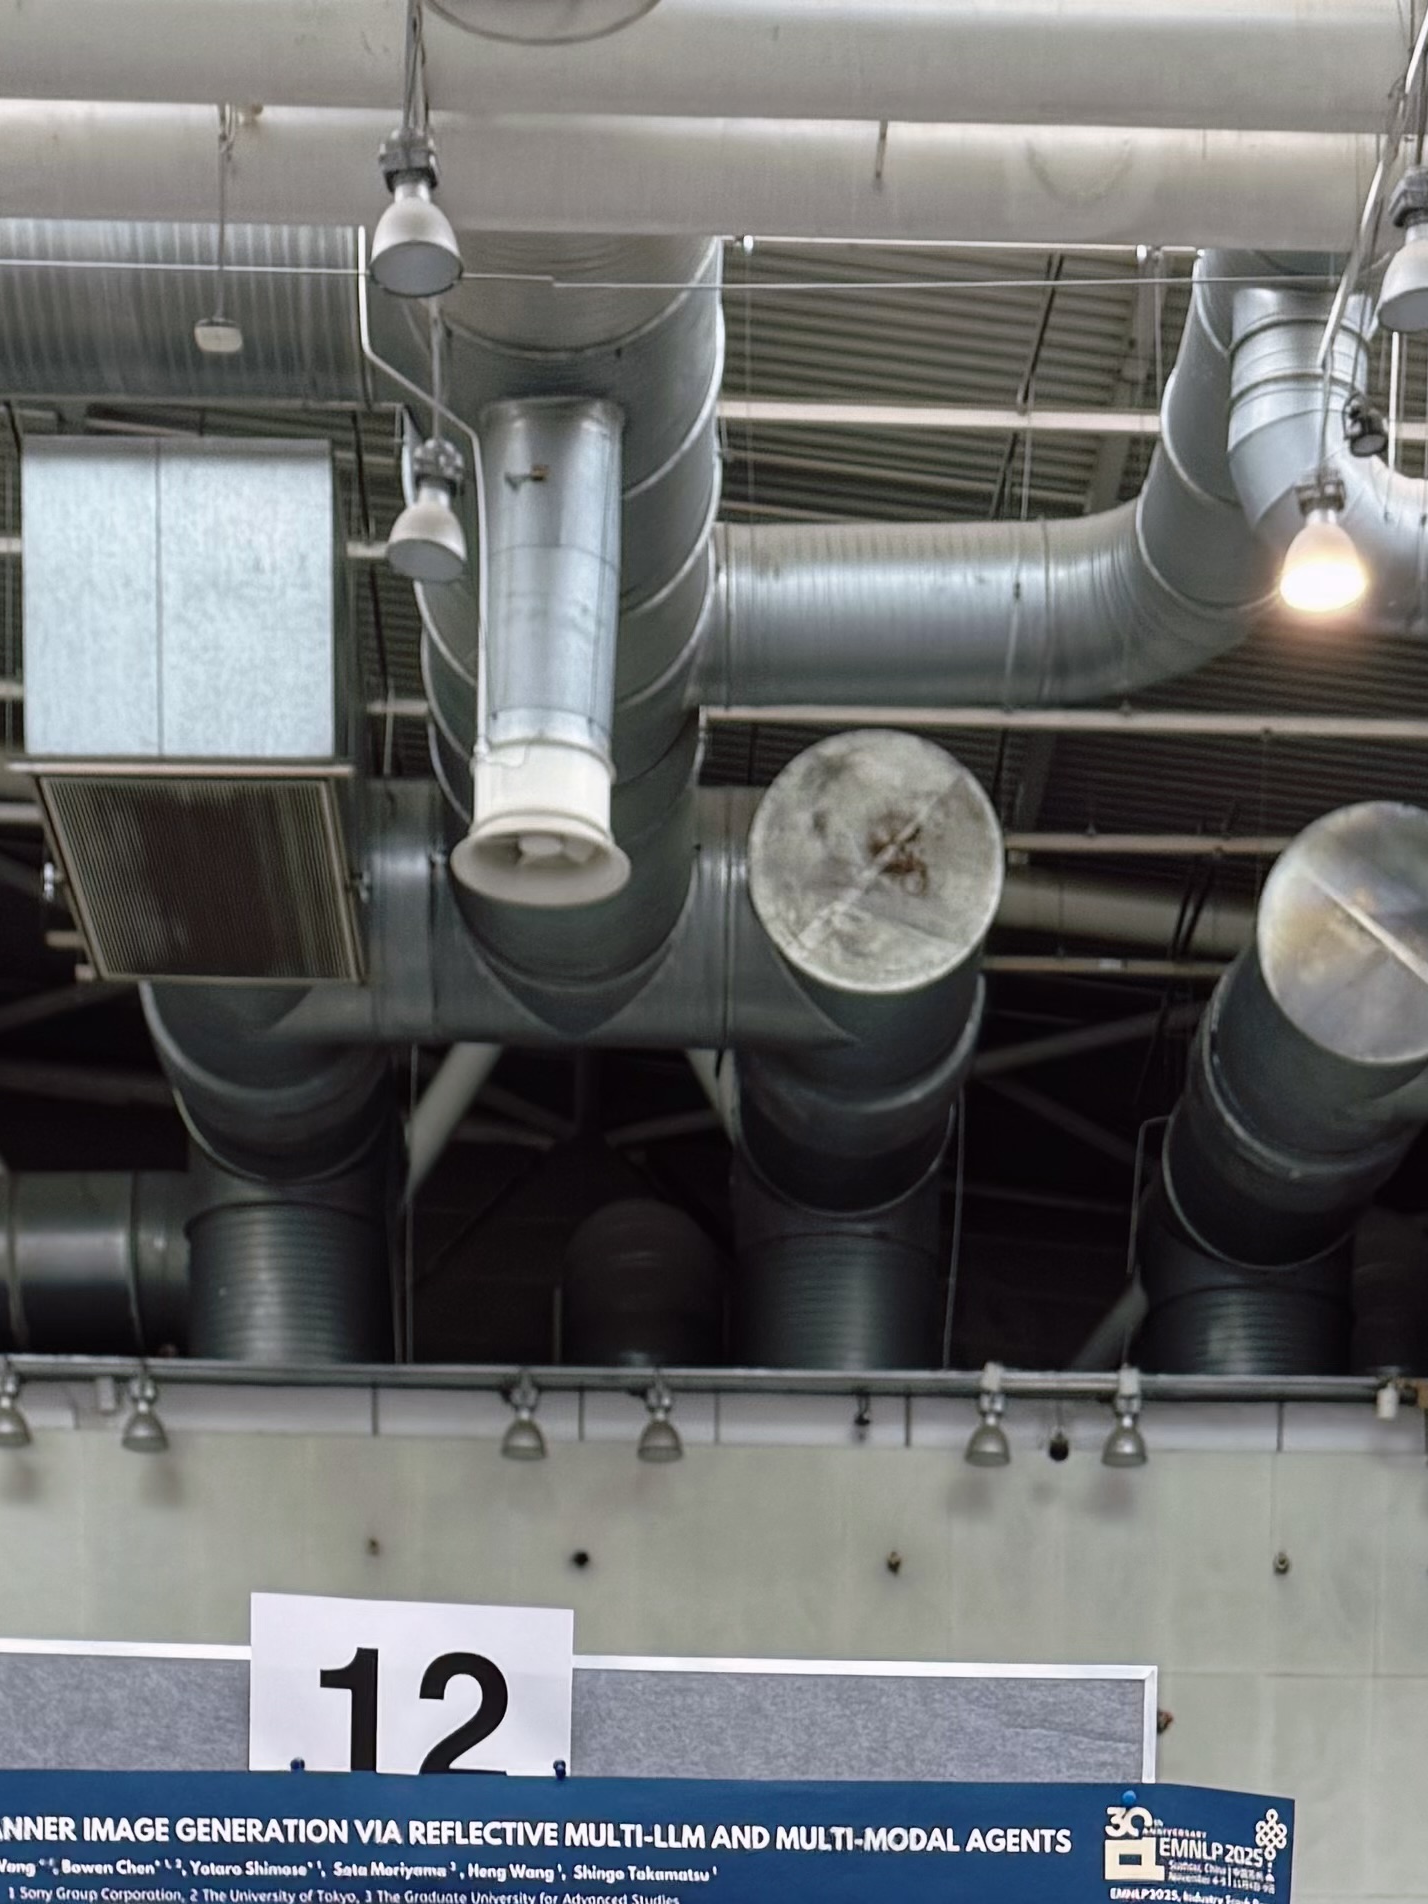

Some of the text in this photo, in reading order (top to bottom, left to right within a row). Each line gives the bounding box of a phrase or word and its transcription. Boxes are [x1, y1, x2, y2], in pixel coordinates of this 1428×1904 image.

[319, 1646, 509, 1775] 12
[82, 1816, 169, 1842] IMAGE
[174, 1816, 348, 1844] GENERATION
[353, 1818, 403, 1844] VIA
[408, 1819, 558, 1846] REFLECTIVE
[564, 1821, 706, 1849] MULTI-LLM
[710, 1824, 770, 1849] AND
[775, 1825, 960, 1852] MULTI-MODAL
[964, 1827, 1072, 1853] AGENTS
[1159, 1838, 1264, 1868] EMNLP 2025
